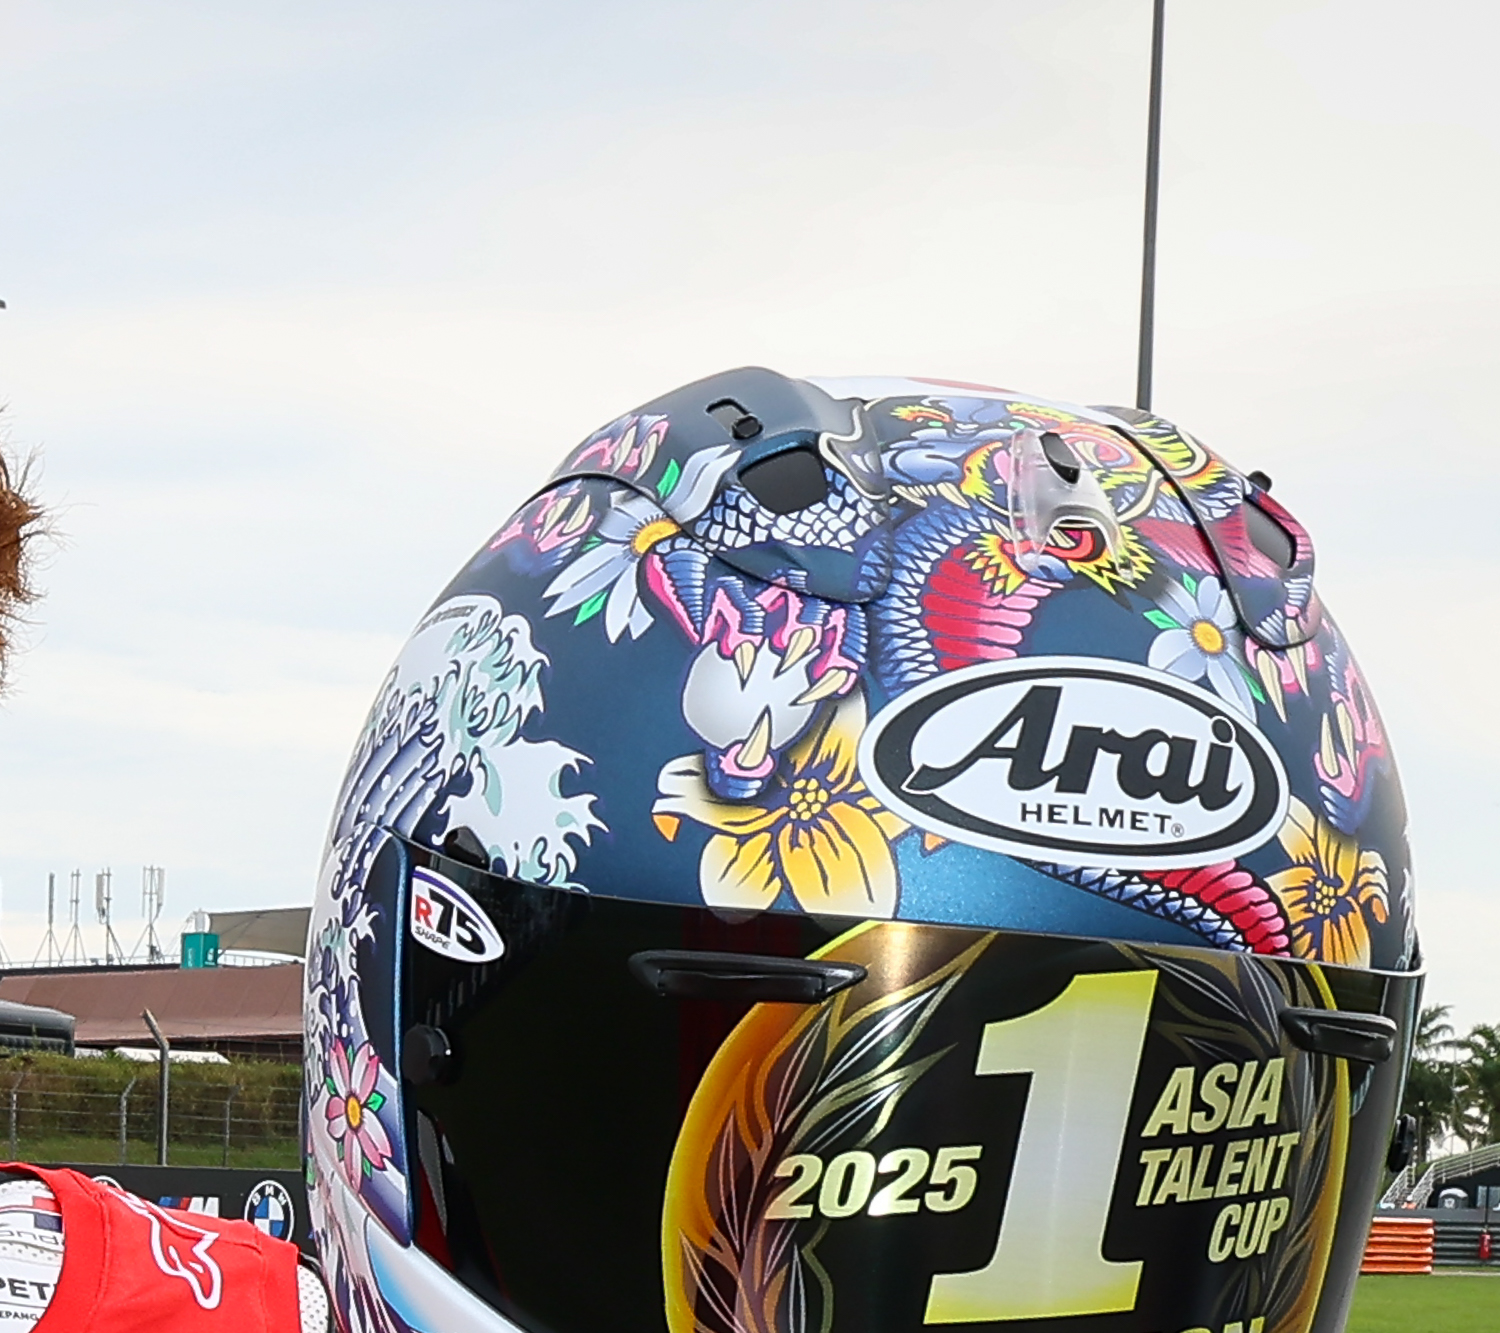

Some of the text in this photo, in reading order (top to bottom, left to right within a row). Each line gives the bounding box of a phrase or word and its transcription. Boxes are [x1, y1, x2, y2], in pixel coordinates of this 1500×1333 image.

[904, 685, 1243, 811] Arai
[1020, 803, 1174, 834] HELMET
[415, 888, 486, 956] R75
[415, 925, 451, 950] SHAPE
[1141, 1057, 1285, 1137] ASIA
[764, 1144, 984, 1221] 2025
[923, 970, 1159, 1325] 1
[1135, 1132, 1301, 1207] TALENT
[1208, 1197, 1290, 1264] CUP
